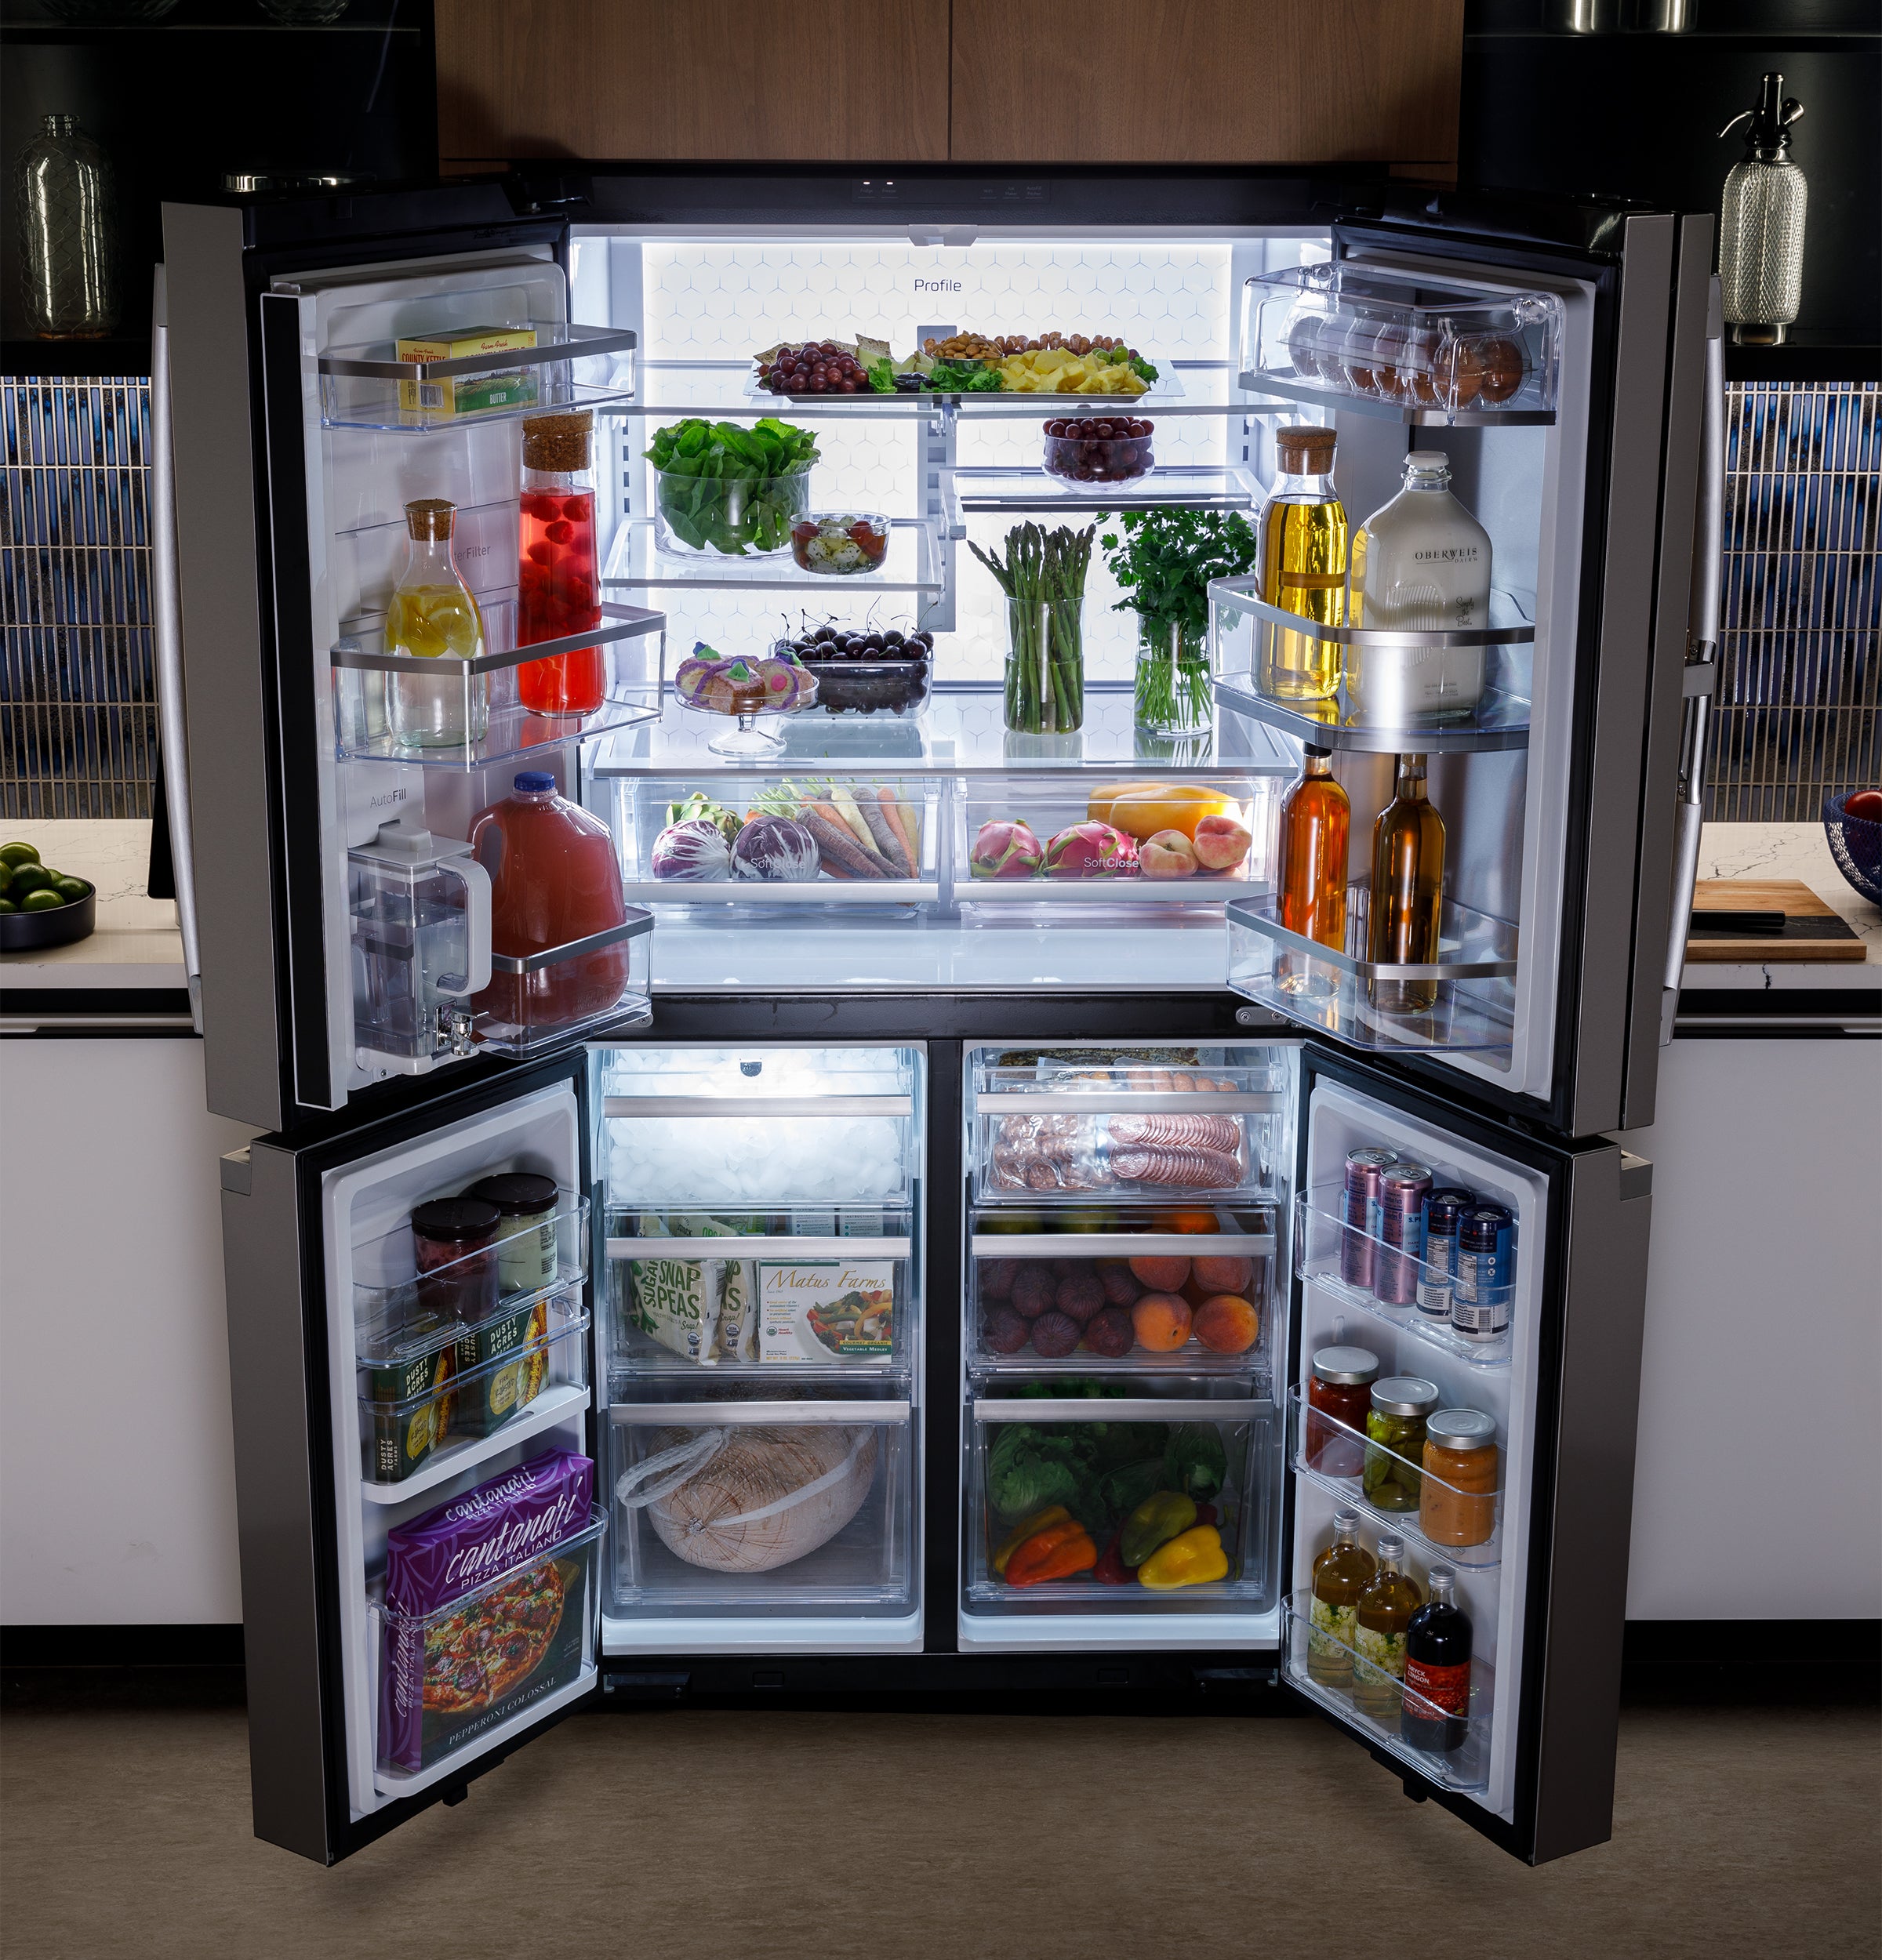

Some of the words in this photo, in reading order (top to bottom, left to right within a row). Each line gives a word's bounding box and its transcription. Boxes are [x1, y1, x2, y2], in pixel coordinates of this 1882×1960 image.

[914, 279, 962, 292] Profile
[401, 353, 425, 363] COUNTY
[489, 392, 508, 405] BUTTER
[453, 546, 492, 562] terFilter
[1415, 547, 1478, 561] OBERWEIS
[369, 788, 407, 808] AutoFill
[1084, 857, 1140, 868] SoftClose
[659, 1261, 701, 1291] SNAP
[766, 1269, 830, 1290] Matus
[837, 1269, 886, 1289] Farms
[657, 1286, 700, 1320] PEAS
[490, 1316, 517, 1344] DUSTY
[491, 1327, 518, 1355] ACRES
[406, 1356, 428, 1386] DUSTY
[406, 1367, 429, 1397] ACRES
[466, 1504, 495, 1521] PIZZA
[494, 1483, 537, 1507] ITALIANO
[460, 1564, 500, 1590] PIZZA
[504, 1530, 562, 1568] ITALIANO
[1408, 1664, 1426, 1677] DRYCK
[1408, 1670, 1430, 1684] LINGON
[449, 1705, 506, 1745] PEPPERONI
[507, 1676, 557, 1711] COLOSSAL
